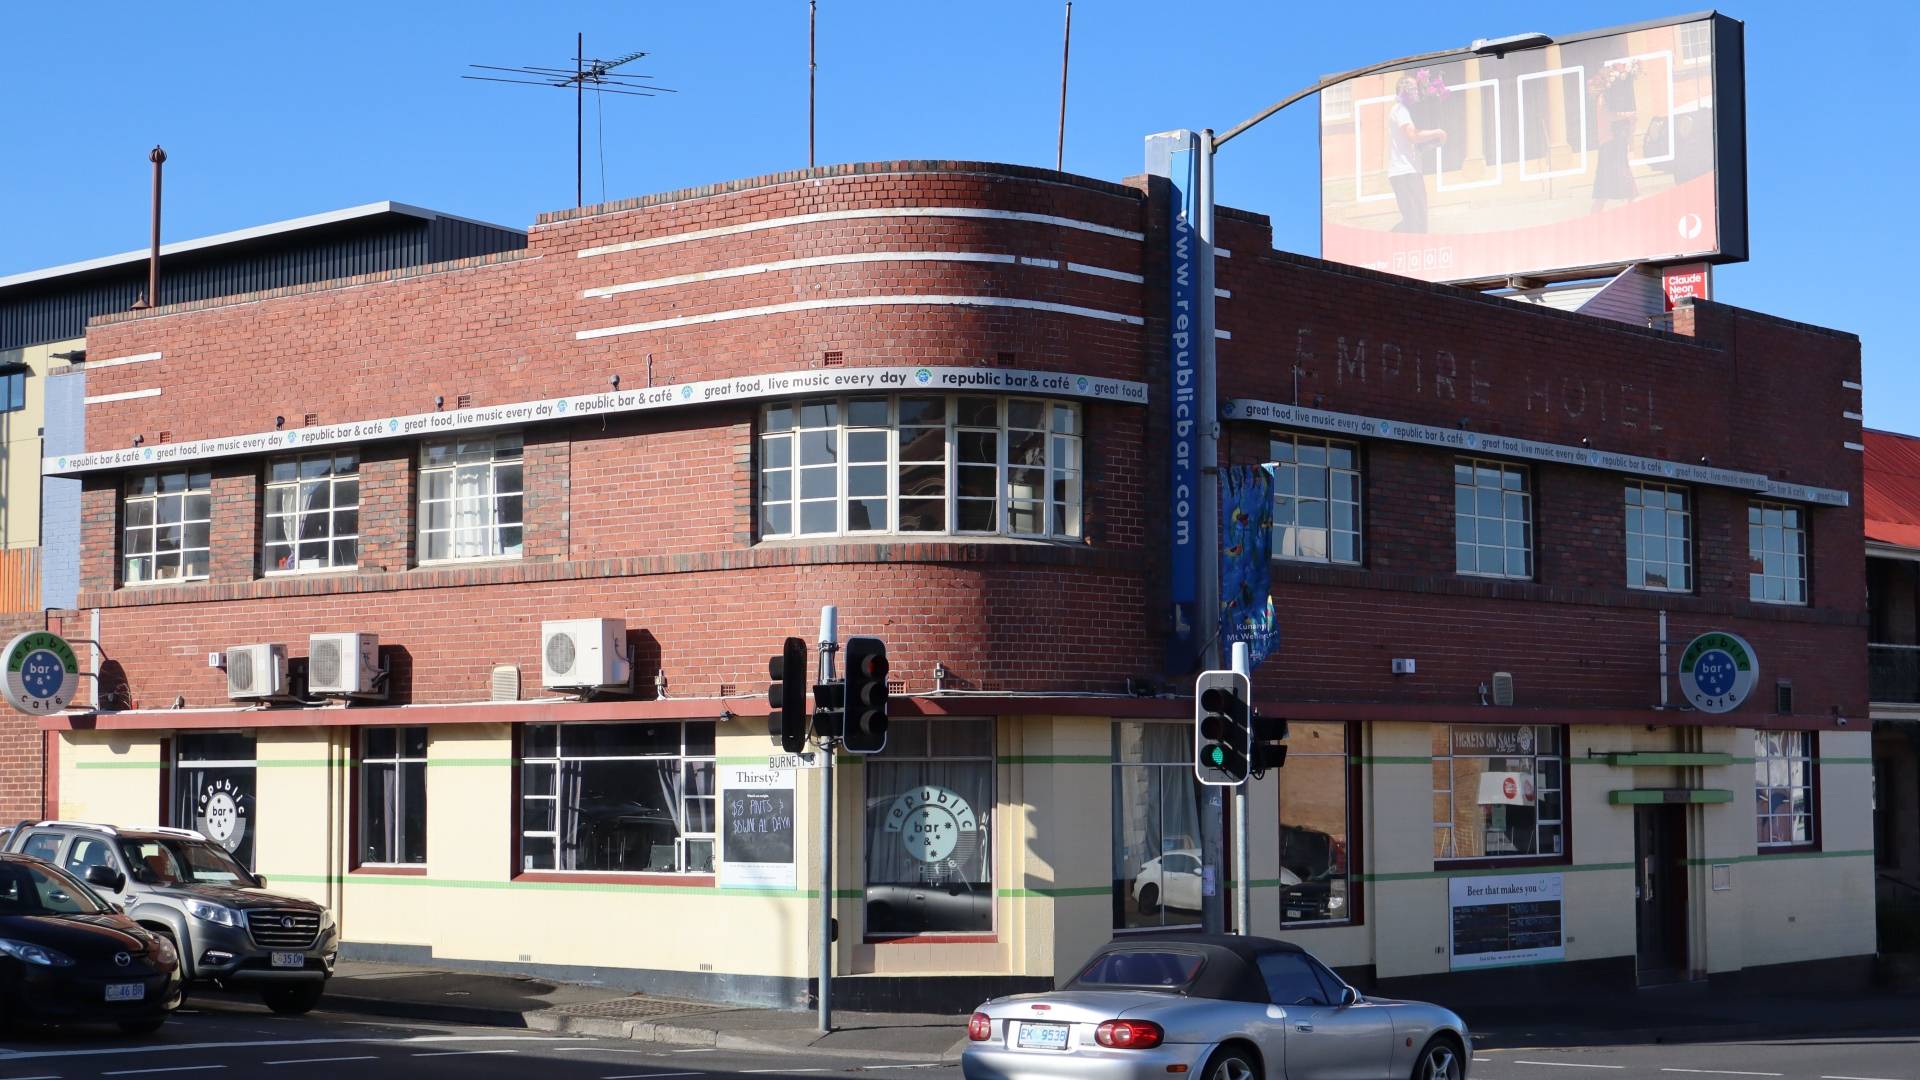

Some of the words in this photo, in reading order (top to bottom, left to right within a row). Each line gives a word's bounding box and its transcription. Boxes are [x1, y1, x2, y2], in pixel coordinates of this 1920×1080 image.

[1669, 273, 1701, 286] Claude
[1669, 285, 1694, 295] Neon
[705, 384, 731, 400] great
[736, 379, 764, 393] food,
[768, 377, 789, 390] live
[792, 373, 829, 387] music
[834, 372, 875, 387] every
[880, 370, 907, 386] day
[942, 371, 1001, 387] republic
[1005, 372, 1029, 387] bar
[1030, 375, 1039, 387] &
[1043, 376, 1070, 390] café
[1094, 381, 1119, 396] great
[575, 394, 615, 412] republic
[618, 392, 635, 407] bar
[638, 391, 646, 404] &
[649, 388, 672, 404] café
[404, 418, 427, 433] great
[430, 414, 455, 428] food,
[457, 411, 473, 424] live
[476, 408, 503, 422] music
[505, 406, 533, 421] every
[536, 404, 553, 418] day
[1246, 403, 1269, 417] great
[1272, 405, 1294, 422] food,
[1295, 408, 1310, 422] live
[1311, 415, 1335, 427] music
[1337, 418, 1359, 431] every
[1361, 420, 1376, 434] day
[301, 426, 335, 443] republic
[337, 425, 352, 438] bar
[354, 424, 361, 436] &
[362, 423, 383, 436] café
[1393, 425, 1423, 440] republic
[1425, 430, 1437, 441] bar
[1440, 431, 1445, 442] &
[1447, 431, 1464, 444] café
[157, 446, 177, 461] great
[179, 444, 200, 457] food,
[201, 440, 215, 453] live
[217, 438, 240, 450] music
[243, 437, 265, 451] every
[268, 434, 283, 448] day
[1482, 436, 1500, 450] great
[1521, 442, 1534, 454] live
[1534, 446, 1554, 458] music
[1556, 449, 1574, 462] every
[1575, 451, 1588, 464] day
[69, 454, 98, 469] republic
[100, 453, 114, 466] bar
[114, 452, 121, 464] &
[122, 450, 140, 463] café
[1602, 455, 1626, 468] republic
[1629, 459, 1639, 470] bar
[11, 636, 76, 671] republic
[1683, 636, 1749, 671] republic
[30, 662, 50, 674] bar
[1702, 663, 1722, 674] bar
[36, 677, 43, 685] &
[1710, 676, 1717, 684] &
[21, 695, 63, 710] café
[1695, 691, 1737, 707] café
[1454, 731, 1485, 748] TICKETS
[1486, 731, 1497, 748] ON
[1498, 730, 1517, 747] SALE
[736, 771, 780, 786] Thirsty?
[198, 778, 245, 815] republic
[212, 805, 226, 816] bar
[887, 789, 973, 831] republic
[217, 819, 222, 828] &
[914, 821, 939, 833] bar
[923, 837, 932, 846] &
[1467, 884, 1483, 897] Beer
[1485, 883, 1499, 895] that
[1500, 882, 1524, 894] makes
[1525, 885, 1538, 896] you
[1020, 1027, 1034, 1040] EK
